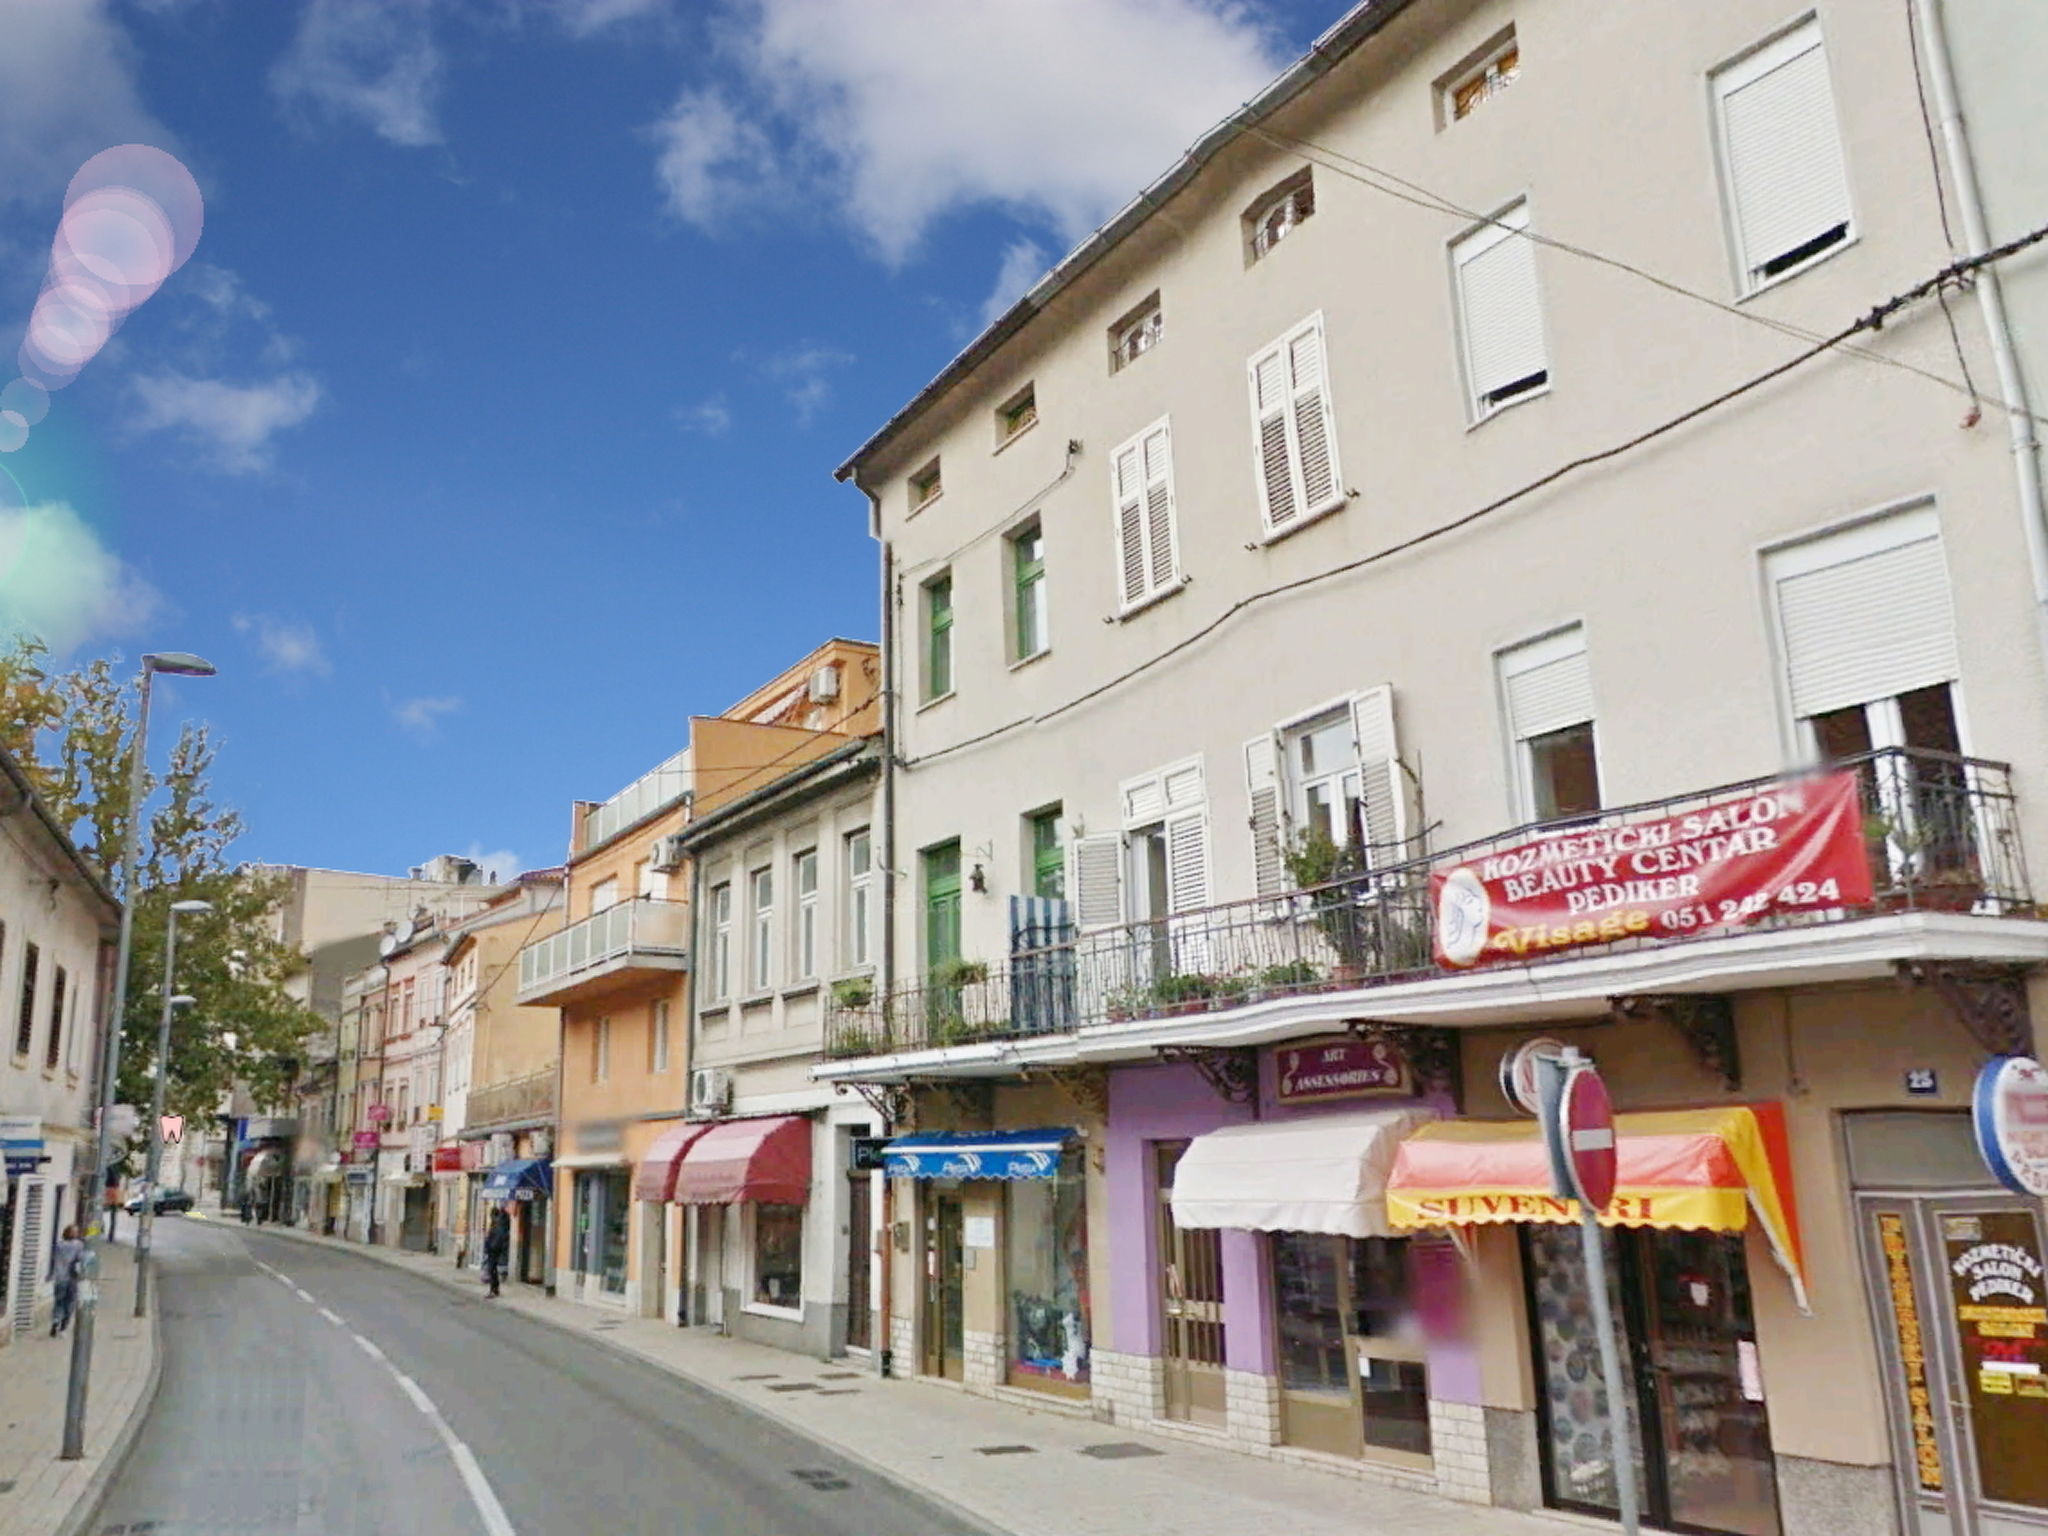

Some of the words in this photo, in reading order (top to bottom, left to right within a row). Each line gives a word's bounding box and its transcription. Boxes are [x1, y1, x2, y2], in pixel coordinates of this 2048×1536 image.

[1504, 855, 1618, 902] BEAUTY
[1631, 827, 1780, 874] CENTAR
[1566, 874, 1699, 915] PEDIKER
[1660, 904, 1713, 929] 051
[1777, 878, 1840, 903] 424
[1417, 1195, 1653, 1220] SUVENRI
